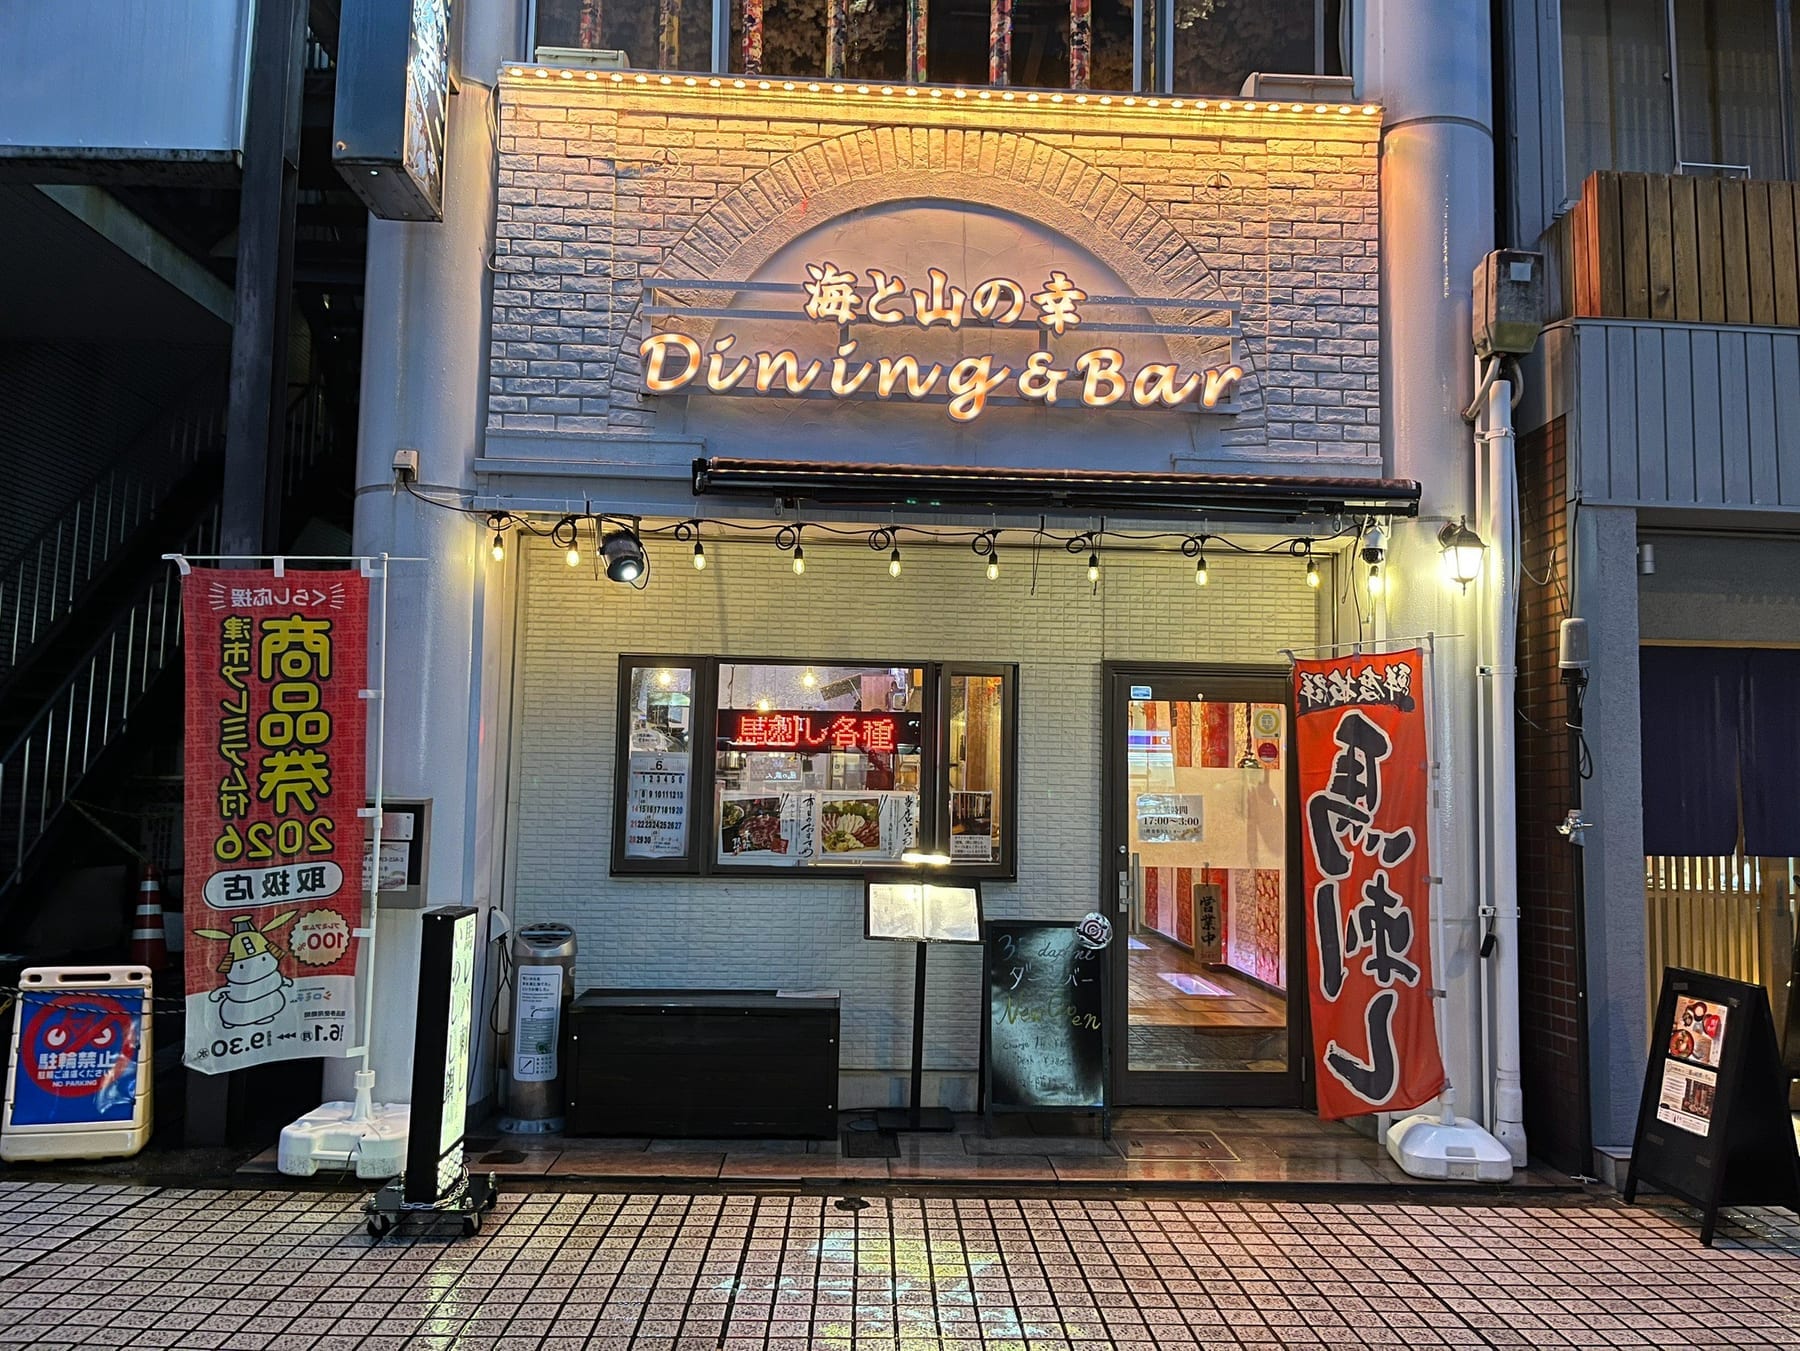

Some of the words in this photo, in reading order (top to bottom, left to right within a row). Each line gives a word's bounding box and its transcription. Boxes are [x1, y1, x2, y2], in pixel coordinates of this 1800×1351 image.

[803, 263, 1088, 337] 海と山の幸
[639, 333, 1010, 421] Dining
[1018, 352, 1068, 406] &
[1076, 346, 1243, 412] Bar
[735, 714, 895, 751] 馬刺し各種
[655, 760, 664, 770] 6
[899, 794, 914, 846] 当店いちお
[1199, 895, 1217, 946] 営業中
[38, 1051, 116, 1070] 駐輪禁止
